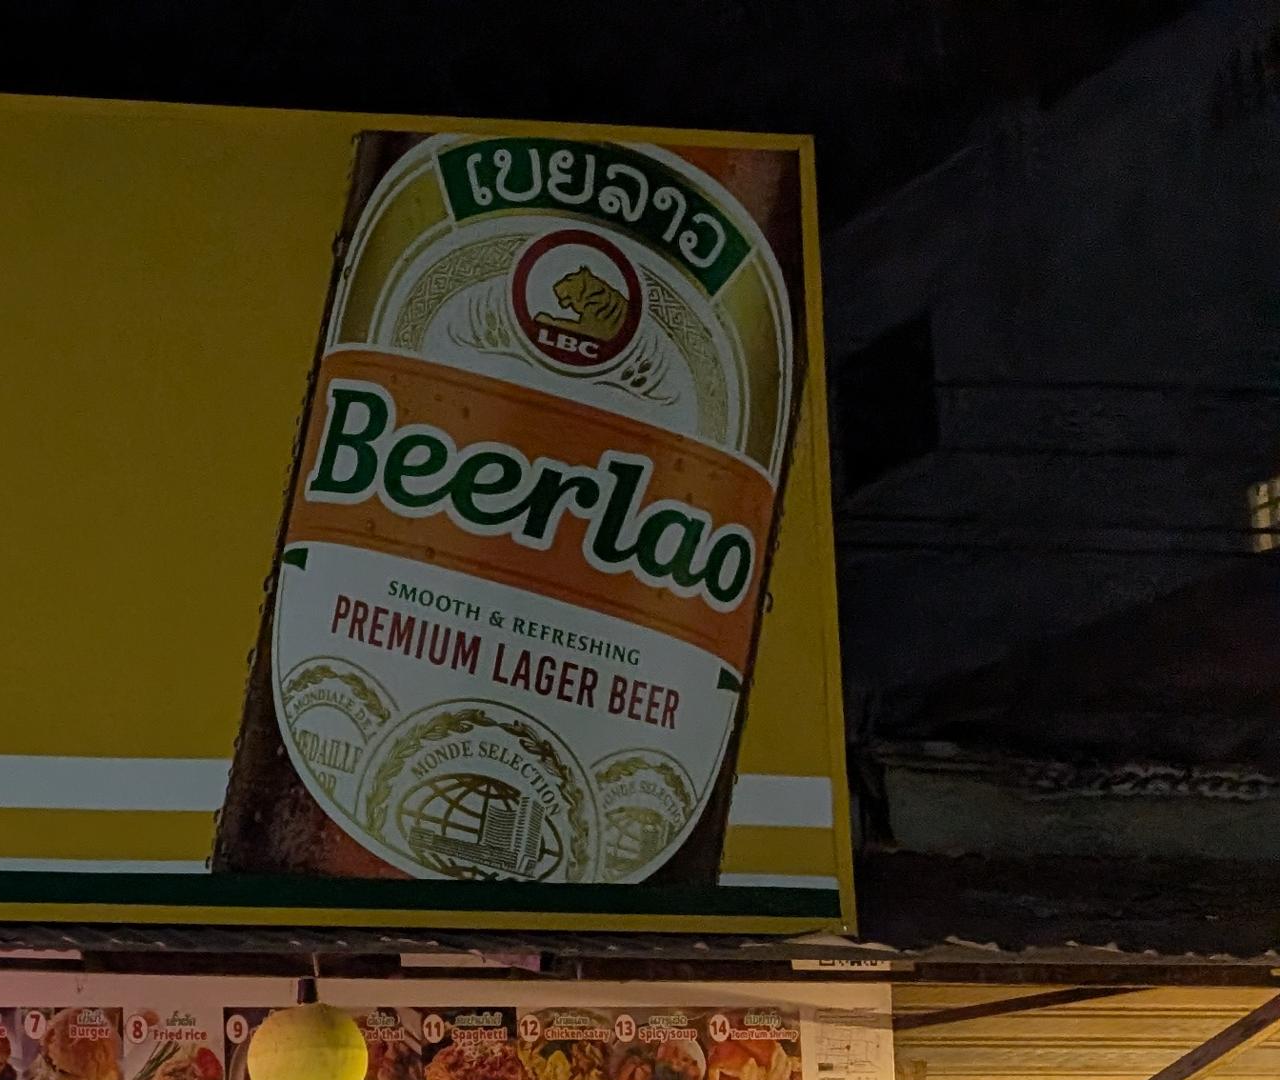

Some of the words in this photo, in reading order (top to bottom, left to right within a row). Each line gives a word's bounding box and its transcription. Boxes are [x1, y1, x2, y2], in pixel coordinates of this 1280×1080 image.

[538, 328, 600, 361] LBC
[308, 386, 754, 606] Beerlao
[387, 580, 481, 622] SMOOTH
[488, 609, 504, 628] &
[512, 616, 641, 667] REFRESHING
[331, 594, 482, 676] PREMIUM
[492, 642, 600, 709] LAGER
[608, 672, 681, 730] BEER
[412, 740, 473, 781] MONDE
[477, 740, 562, 817] SELECTION
[30, 1013, 41, 1033] 7
[132, 1020, 143, 1039] 8
[232, 1022, 243, 1038] 9
[424, 1021, 442, 1037] 11
[521, 1019, 540, 1036] 12
[615, 1020, 634, 1037] 13
[710, 1020, 729, 1037] 14
[69, 1026, 110, 1040] Burger
[153, 1029, 183, 1041] Fried
[184, 1029, 208, 1041] rice
[451, 1028, 508, 1043] Spaghetti
[544, 1028, 578, 1040] Chicken
[578, 1029, 611, 1042] satay
[639, 1027, 669, 1043] Spicy
[670, 1029, 698, 1042] soup
[750, 1030, 768, 1040] Yum
[769, 1029, 799, 1042] shrimp
